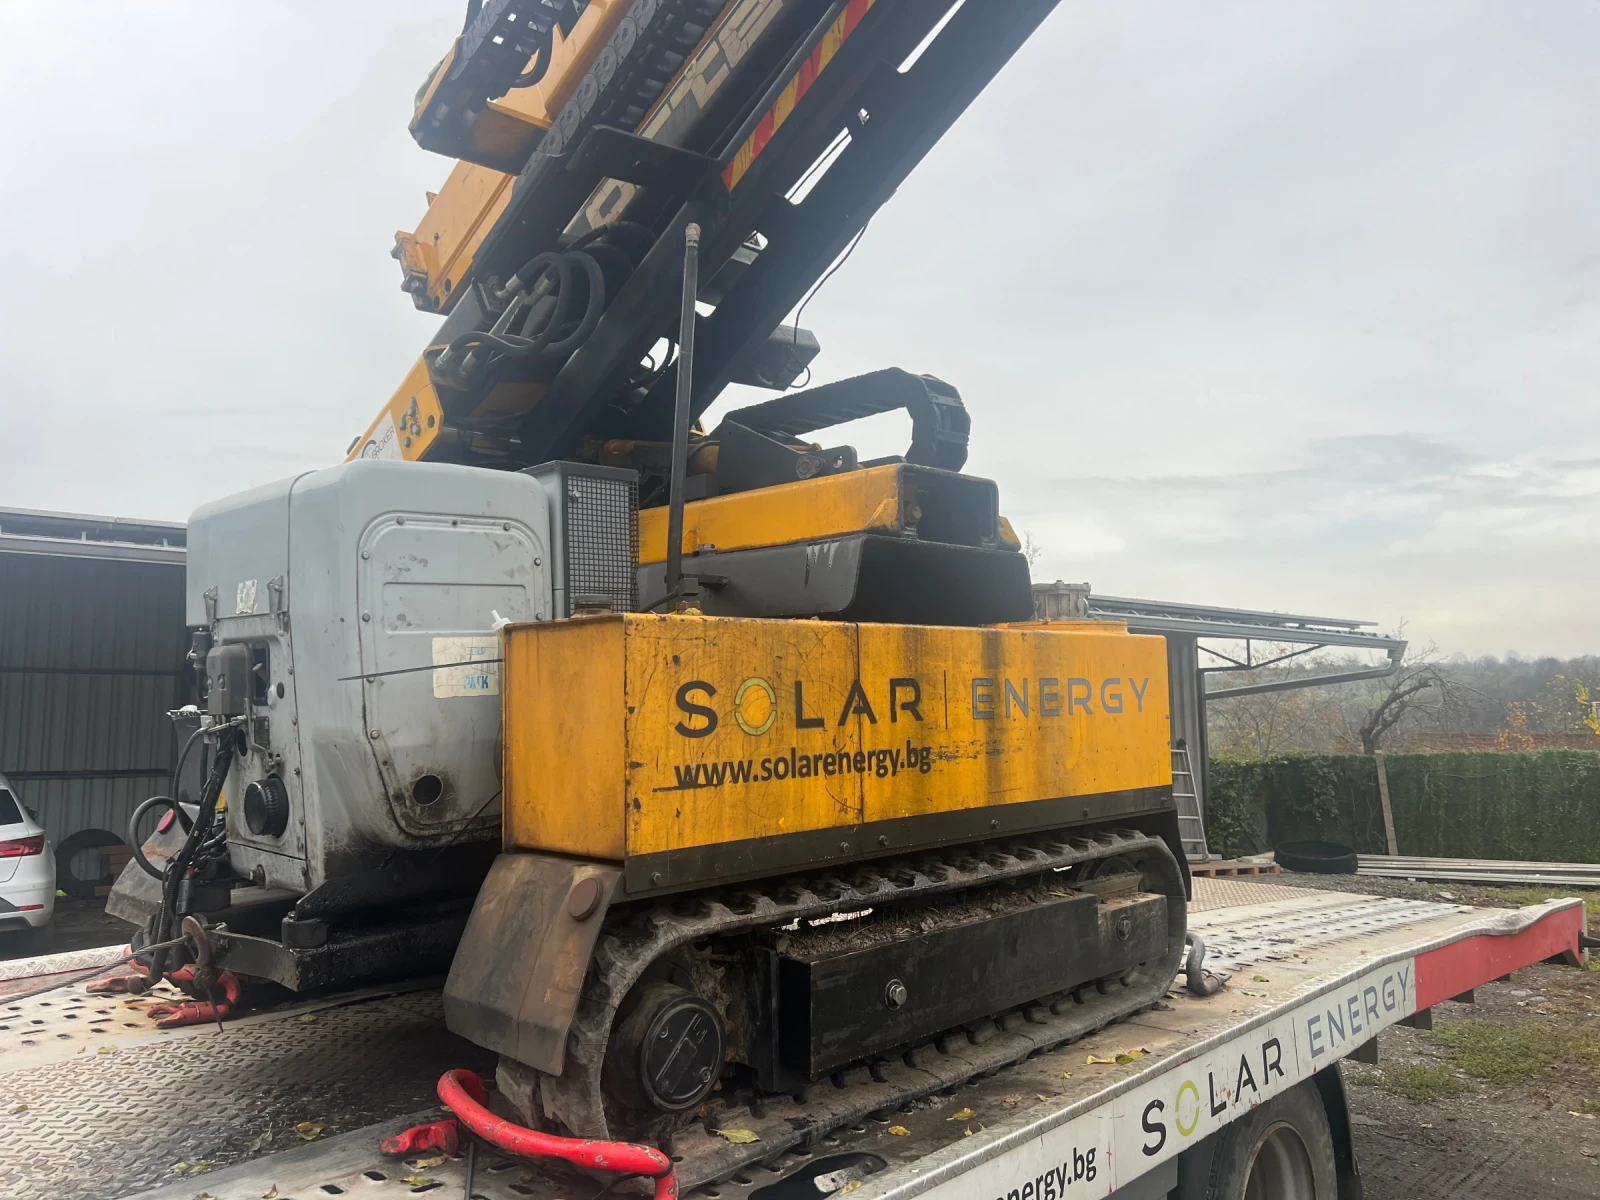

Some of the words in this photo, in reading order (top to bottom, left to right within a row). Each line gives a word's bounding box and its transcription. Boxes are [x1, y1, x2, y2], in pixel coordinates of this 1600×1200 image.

[674, 677, 924, 738] SOLAR
[972, 677, 1149, 719] ENERGY
[674, 740, 932, 787] www.solarenergy.bg
[1141, 1037, 1285, 1156] SOLAR
[1307, 966, 1410, 1058] ENERGY
